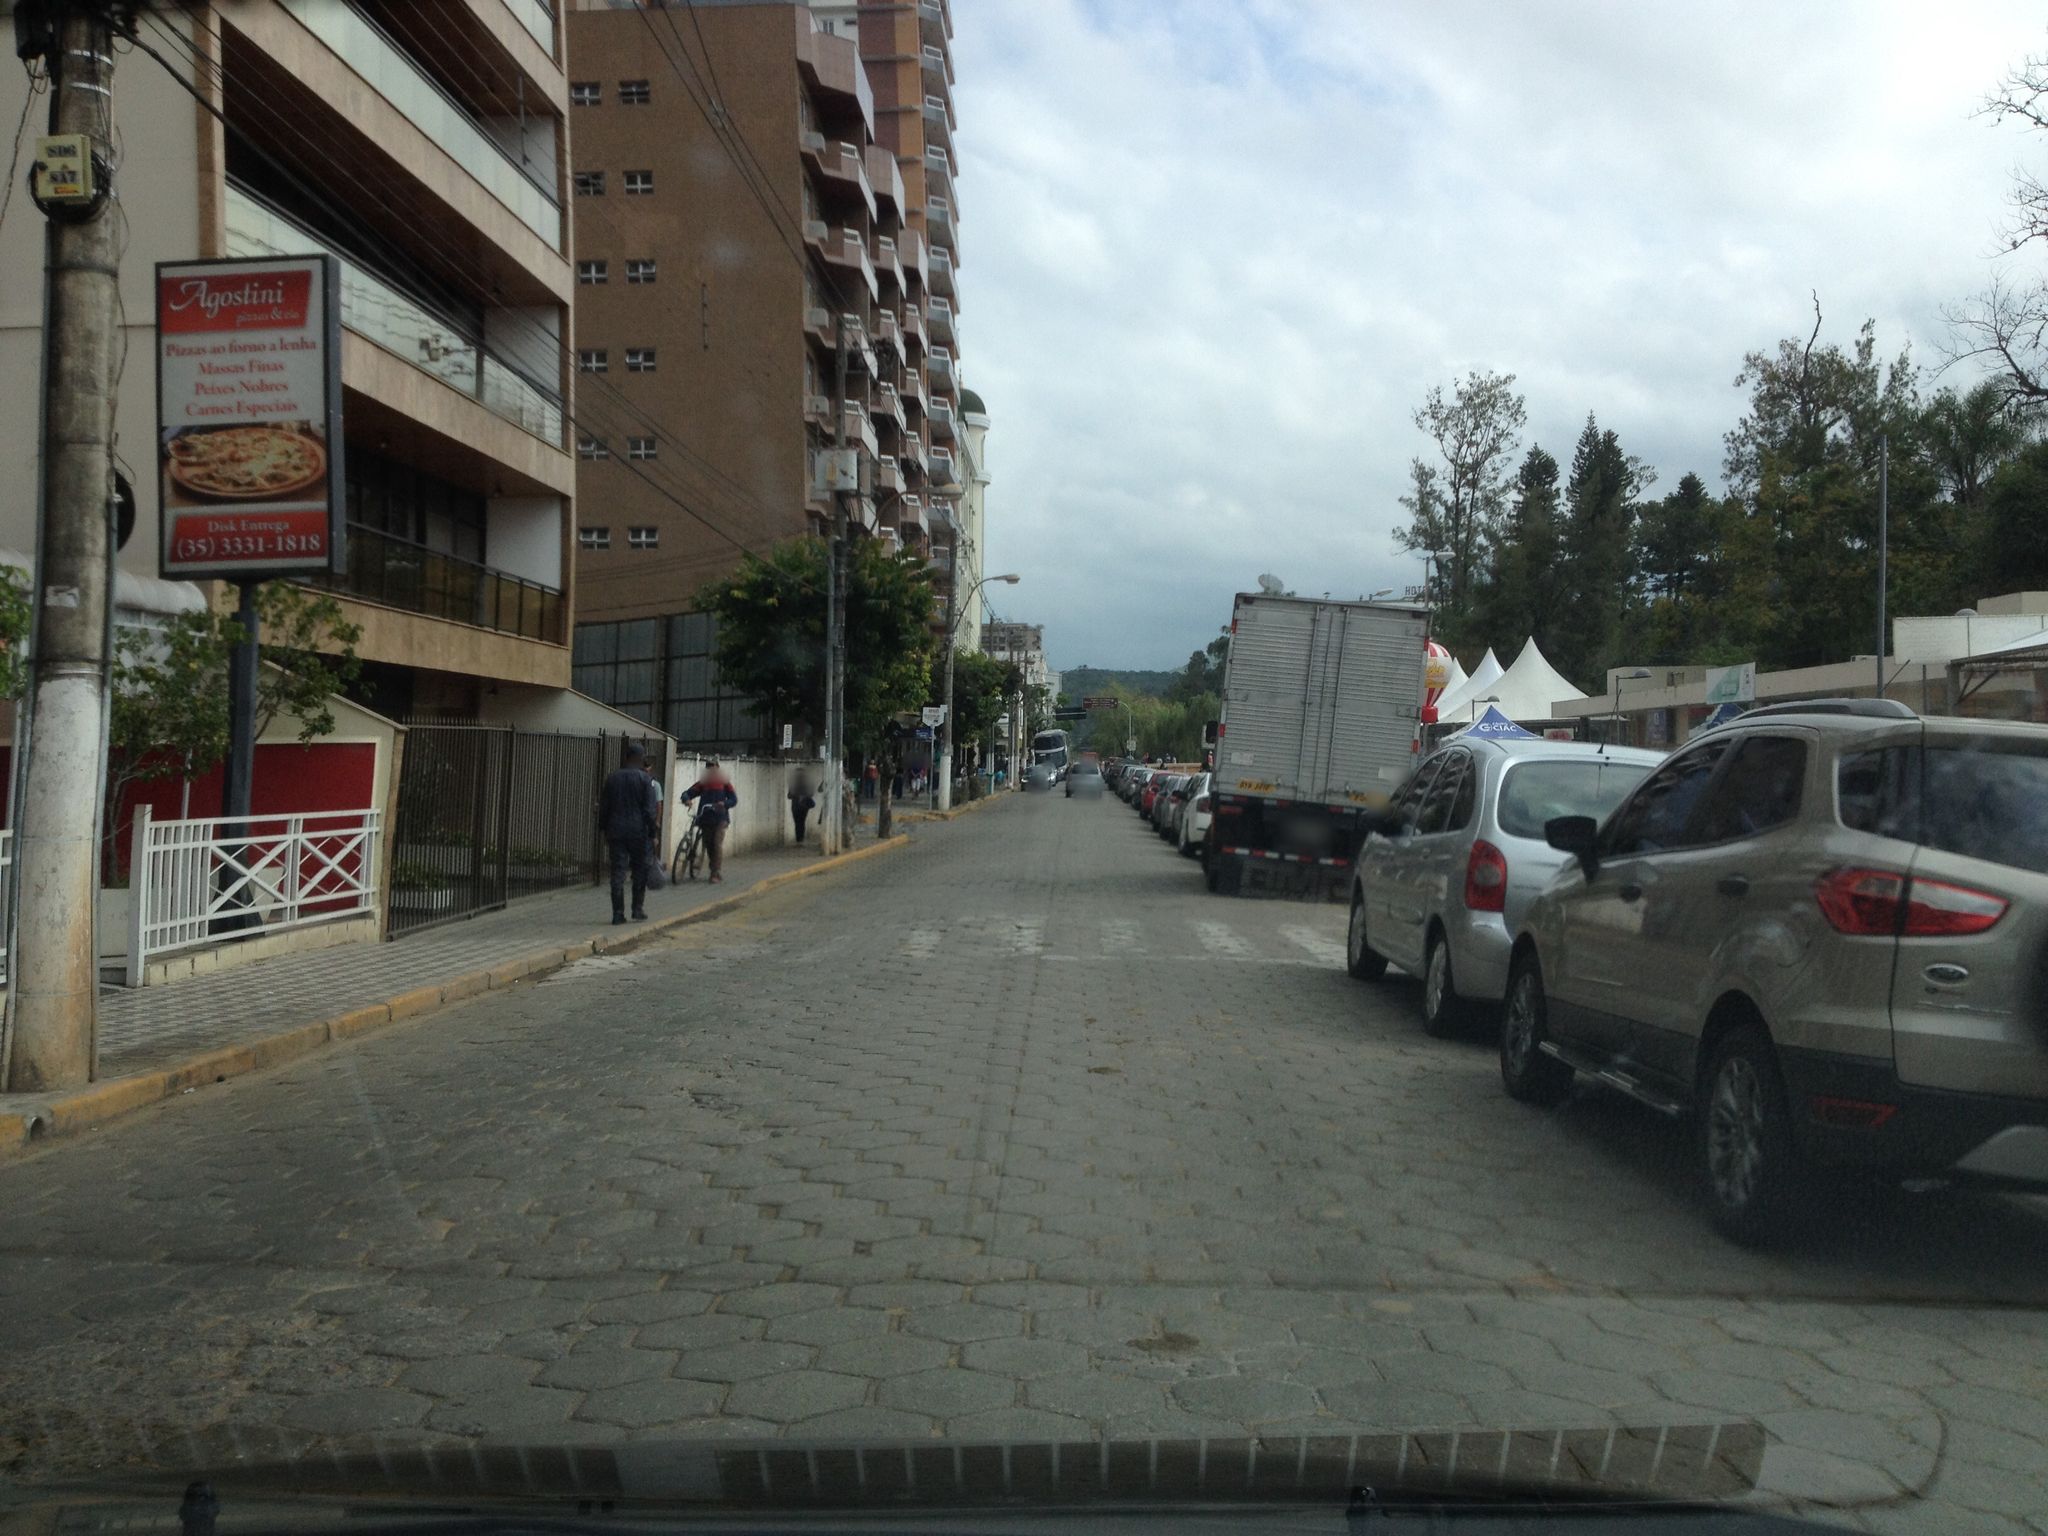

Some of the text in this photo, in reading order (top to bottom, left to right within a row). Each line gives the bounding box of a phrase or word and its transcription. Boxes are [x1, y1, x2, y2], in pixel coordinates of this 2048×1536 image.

[170, 280, 284, 318] Agostini
[271, 306, 282, 320] &
[166, 337, 316, 357] Pizzas ao forno a lenha
[199, 359, 285, 375] Massas Finas
[195, 379, 289, 396] Peixes Nobres
[185, 400, 298, 417] Carnes Especiais
[207, 519, 289, 534] Disk Entrega
[177, 533, 321, 559] (35) 3331-1818
